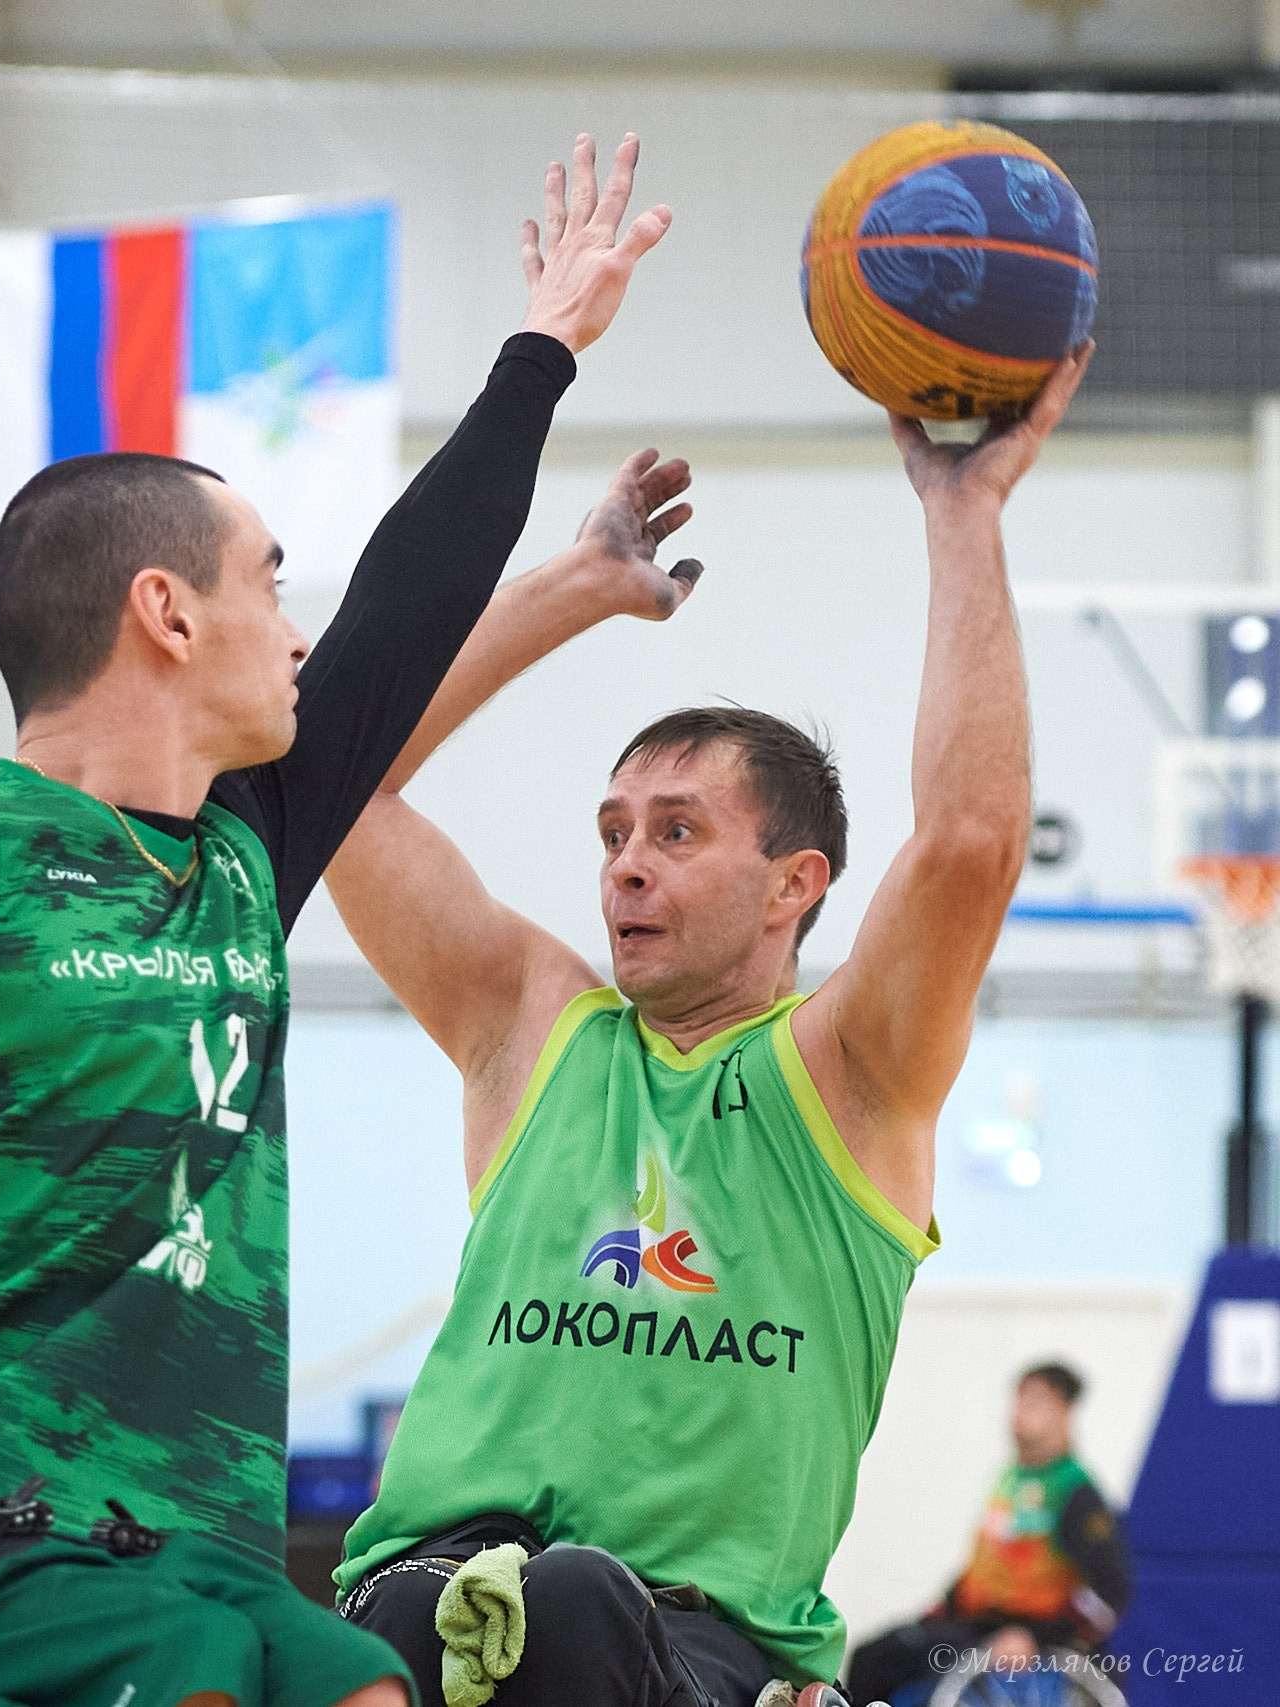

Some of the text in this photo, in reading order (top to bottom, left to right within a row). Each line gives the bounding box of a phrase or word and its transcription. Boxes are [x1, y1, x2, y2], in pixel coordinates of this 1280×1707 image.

[47, 868, 98, 884] LYKIA
[188, 1012, 250, 1133] 12
[487, 1299, 805, 1373] ЛОКОПЛАСТ
